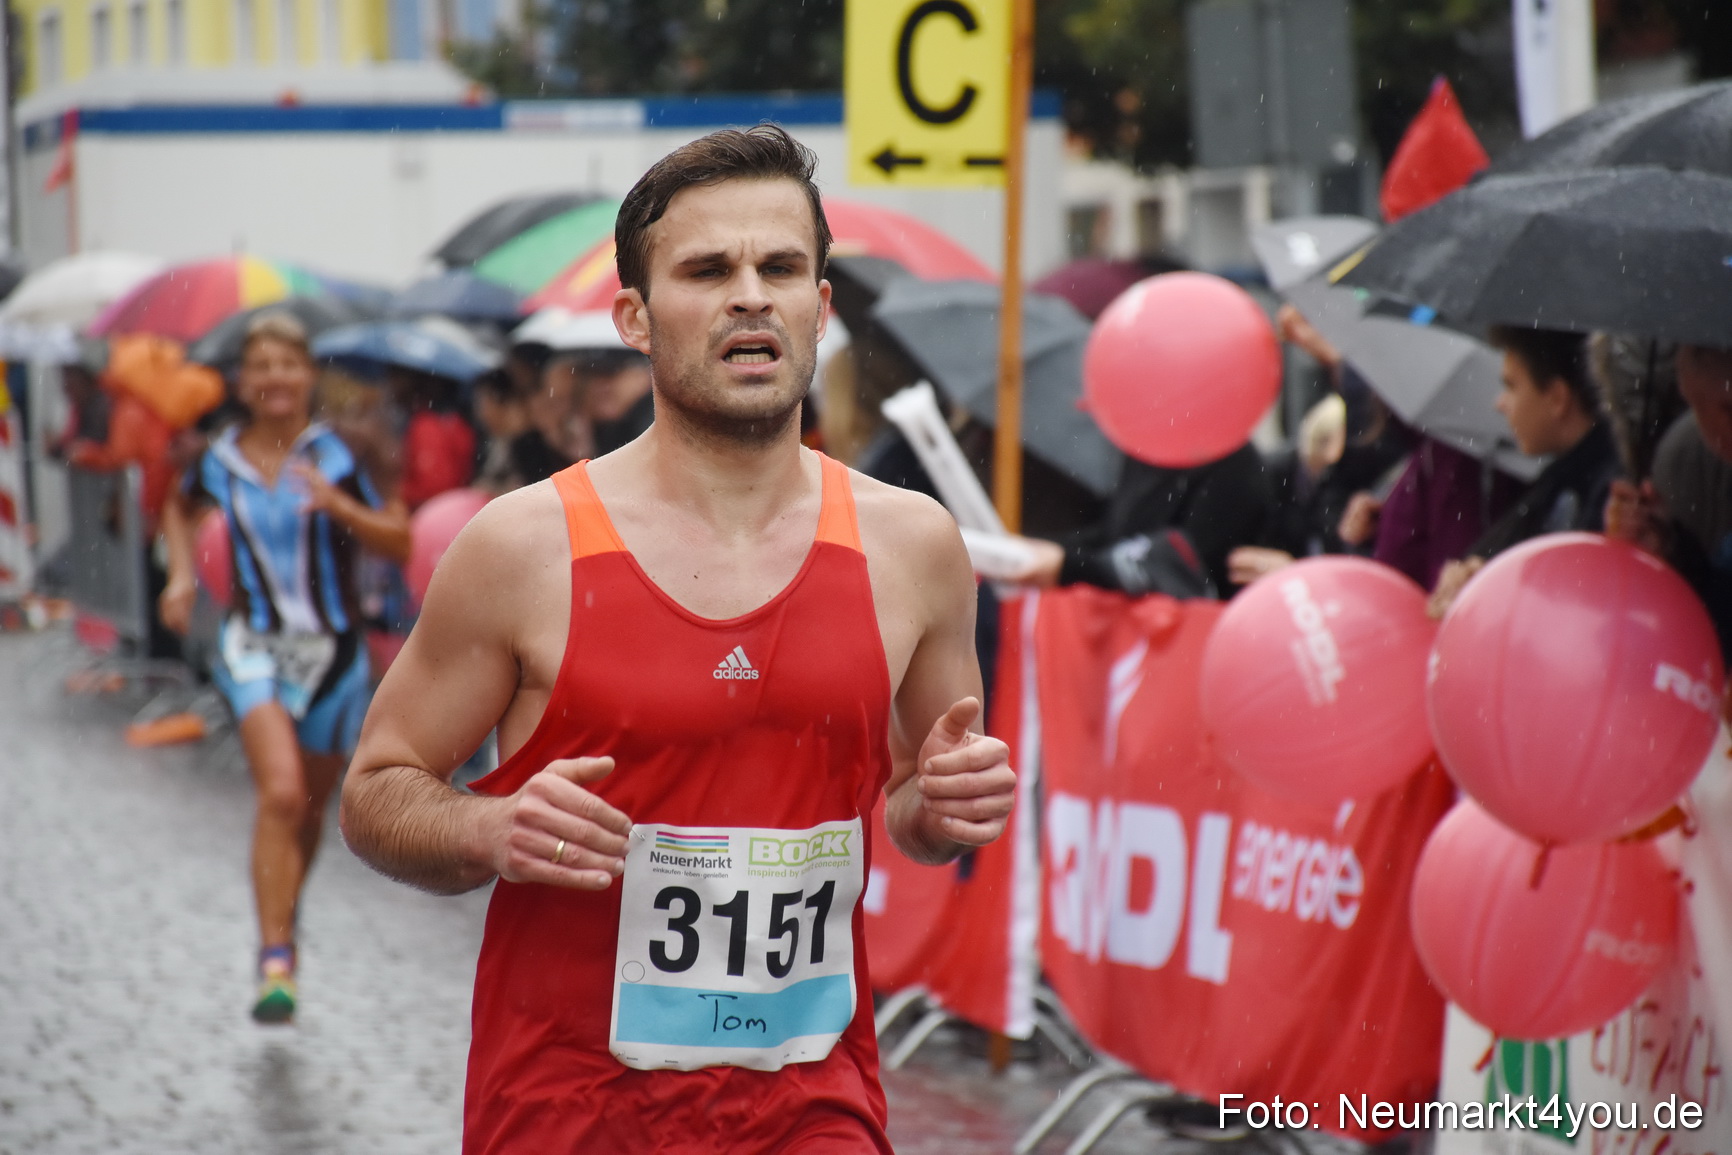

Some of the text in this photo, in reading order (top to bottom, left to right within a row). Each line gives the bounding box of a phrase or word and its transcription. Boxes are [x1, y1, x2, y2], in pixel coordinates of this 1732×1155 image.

[897, 0, 977, 124] C
[713, 667, 759, 680] adidas
[650, 850, 733, 869] NeuerMarkt
[748, 830, 852, 867] BOCK
[652, 866, 729, 880] einkaufen leben genießen
[747, 866, 787, 879] inspired
[789, 869, 800, 879] by
[649, 880, 836, 979] 3151
[698, 993, 767, 1033] Tom
